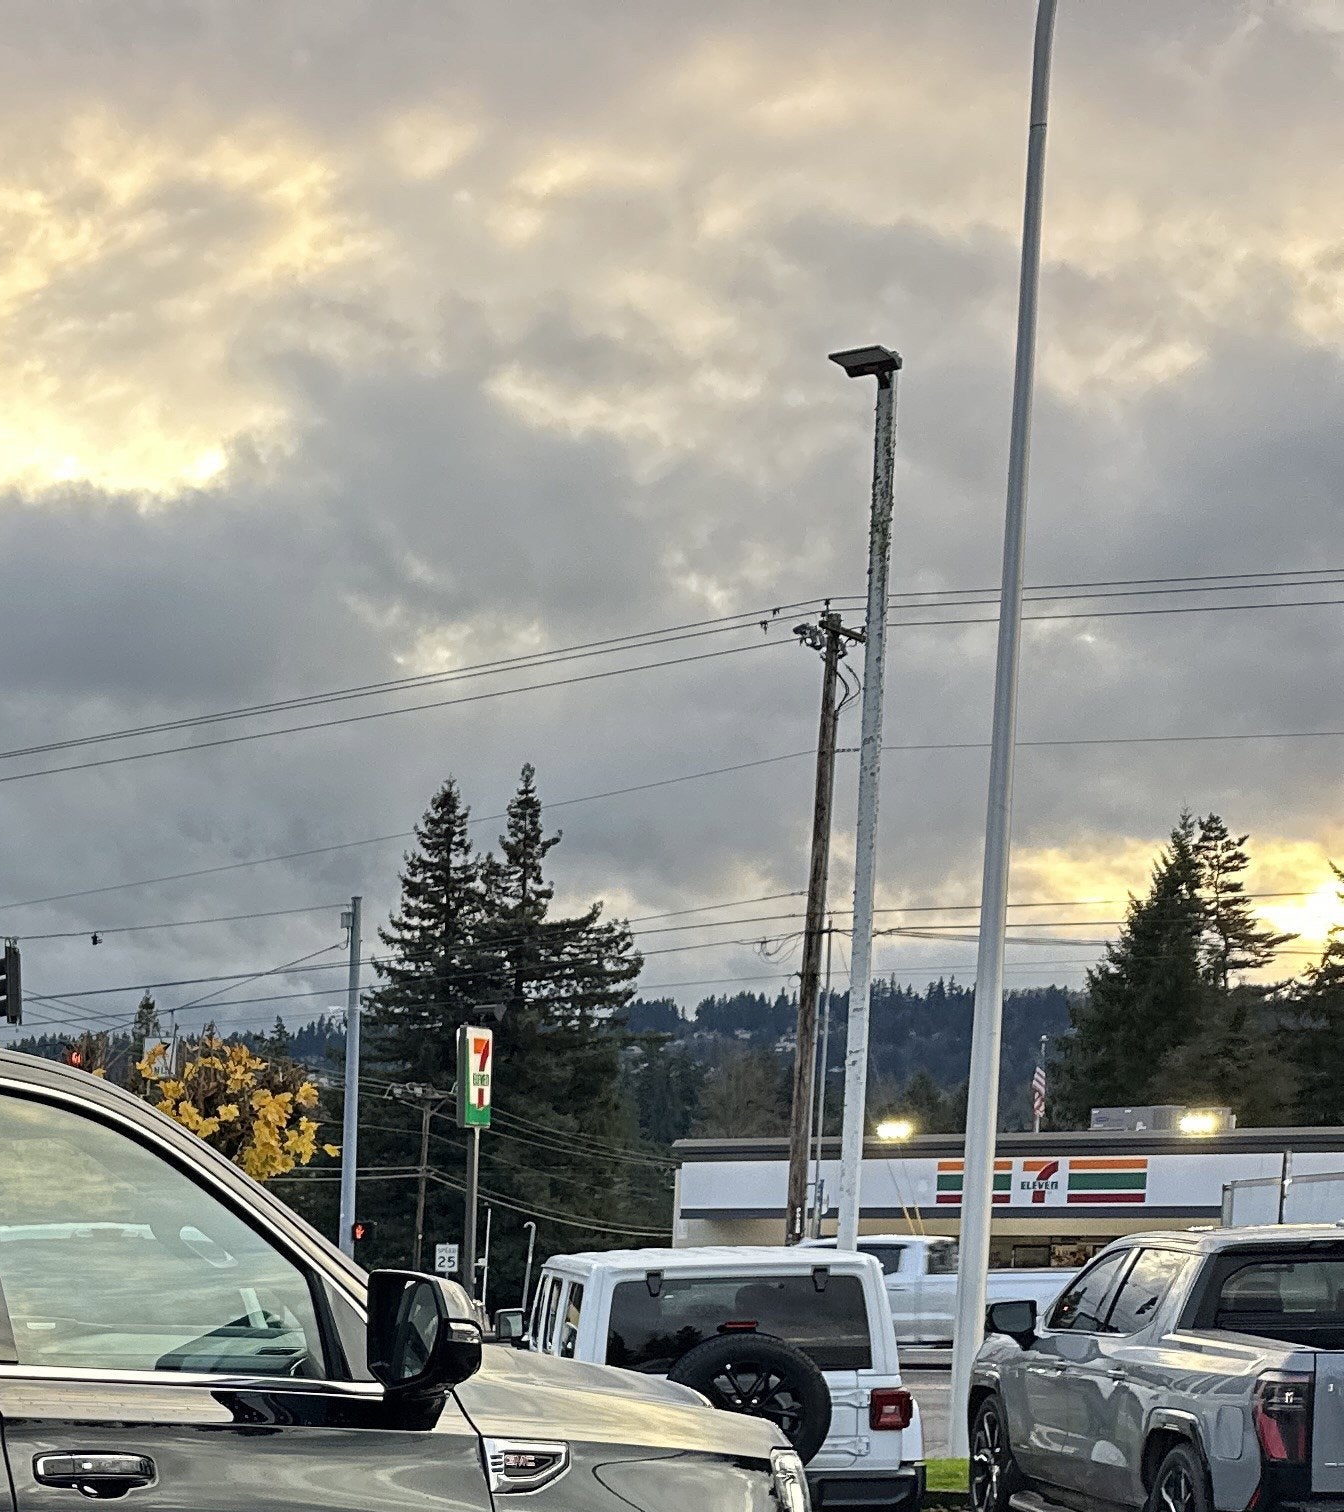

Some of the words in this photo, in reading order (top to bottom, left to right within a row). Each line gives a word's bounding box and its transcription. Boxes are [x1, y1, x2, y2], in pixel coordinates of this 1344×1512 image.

[474, 1038, 490, 1109] 7
[1023, 1160, 1059, 1203] 7
[437, 1256, 456, 1268] 25
